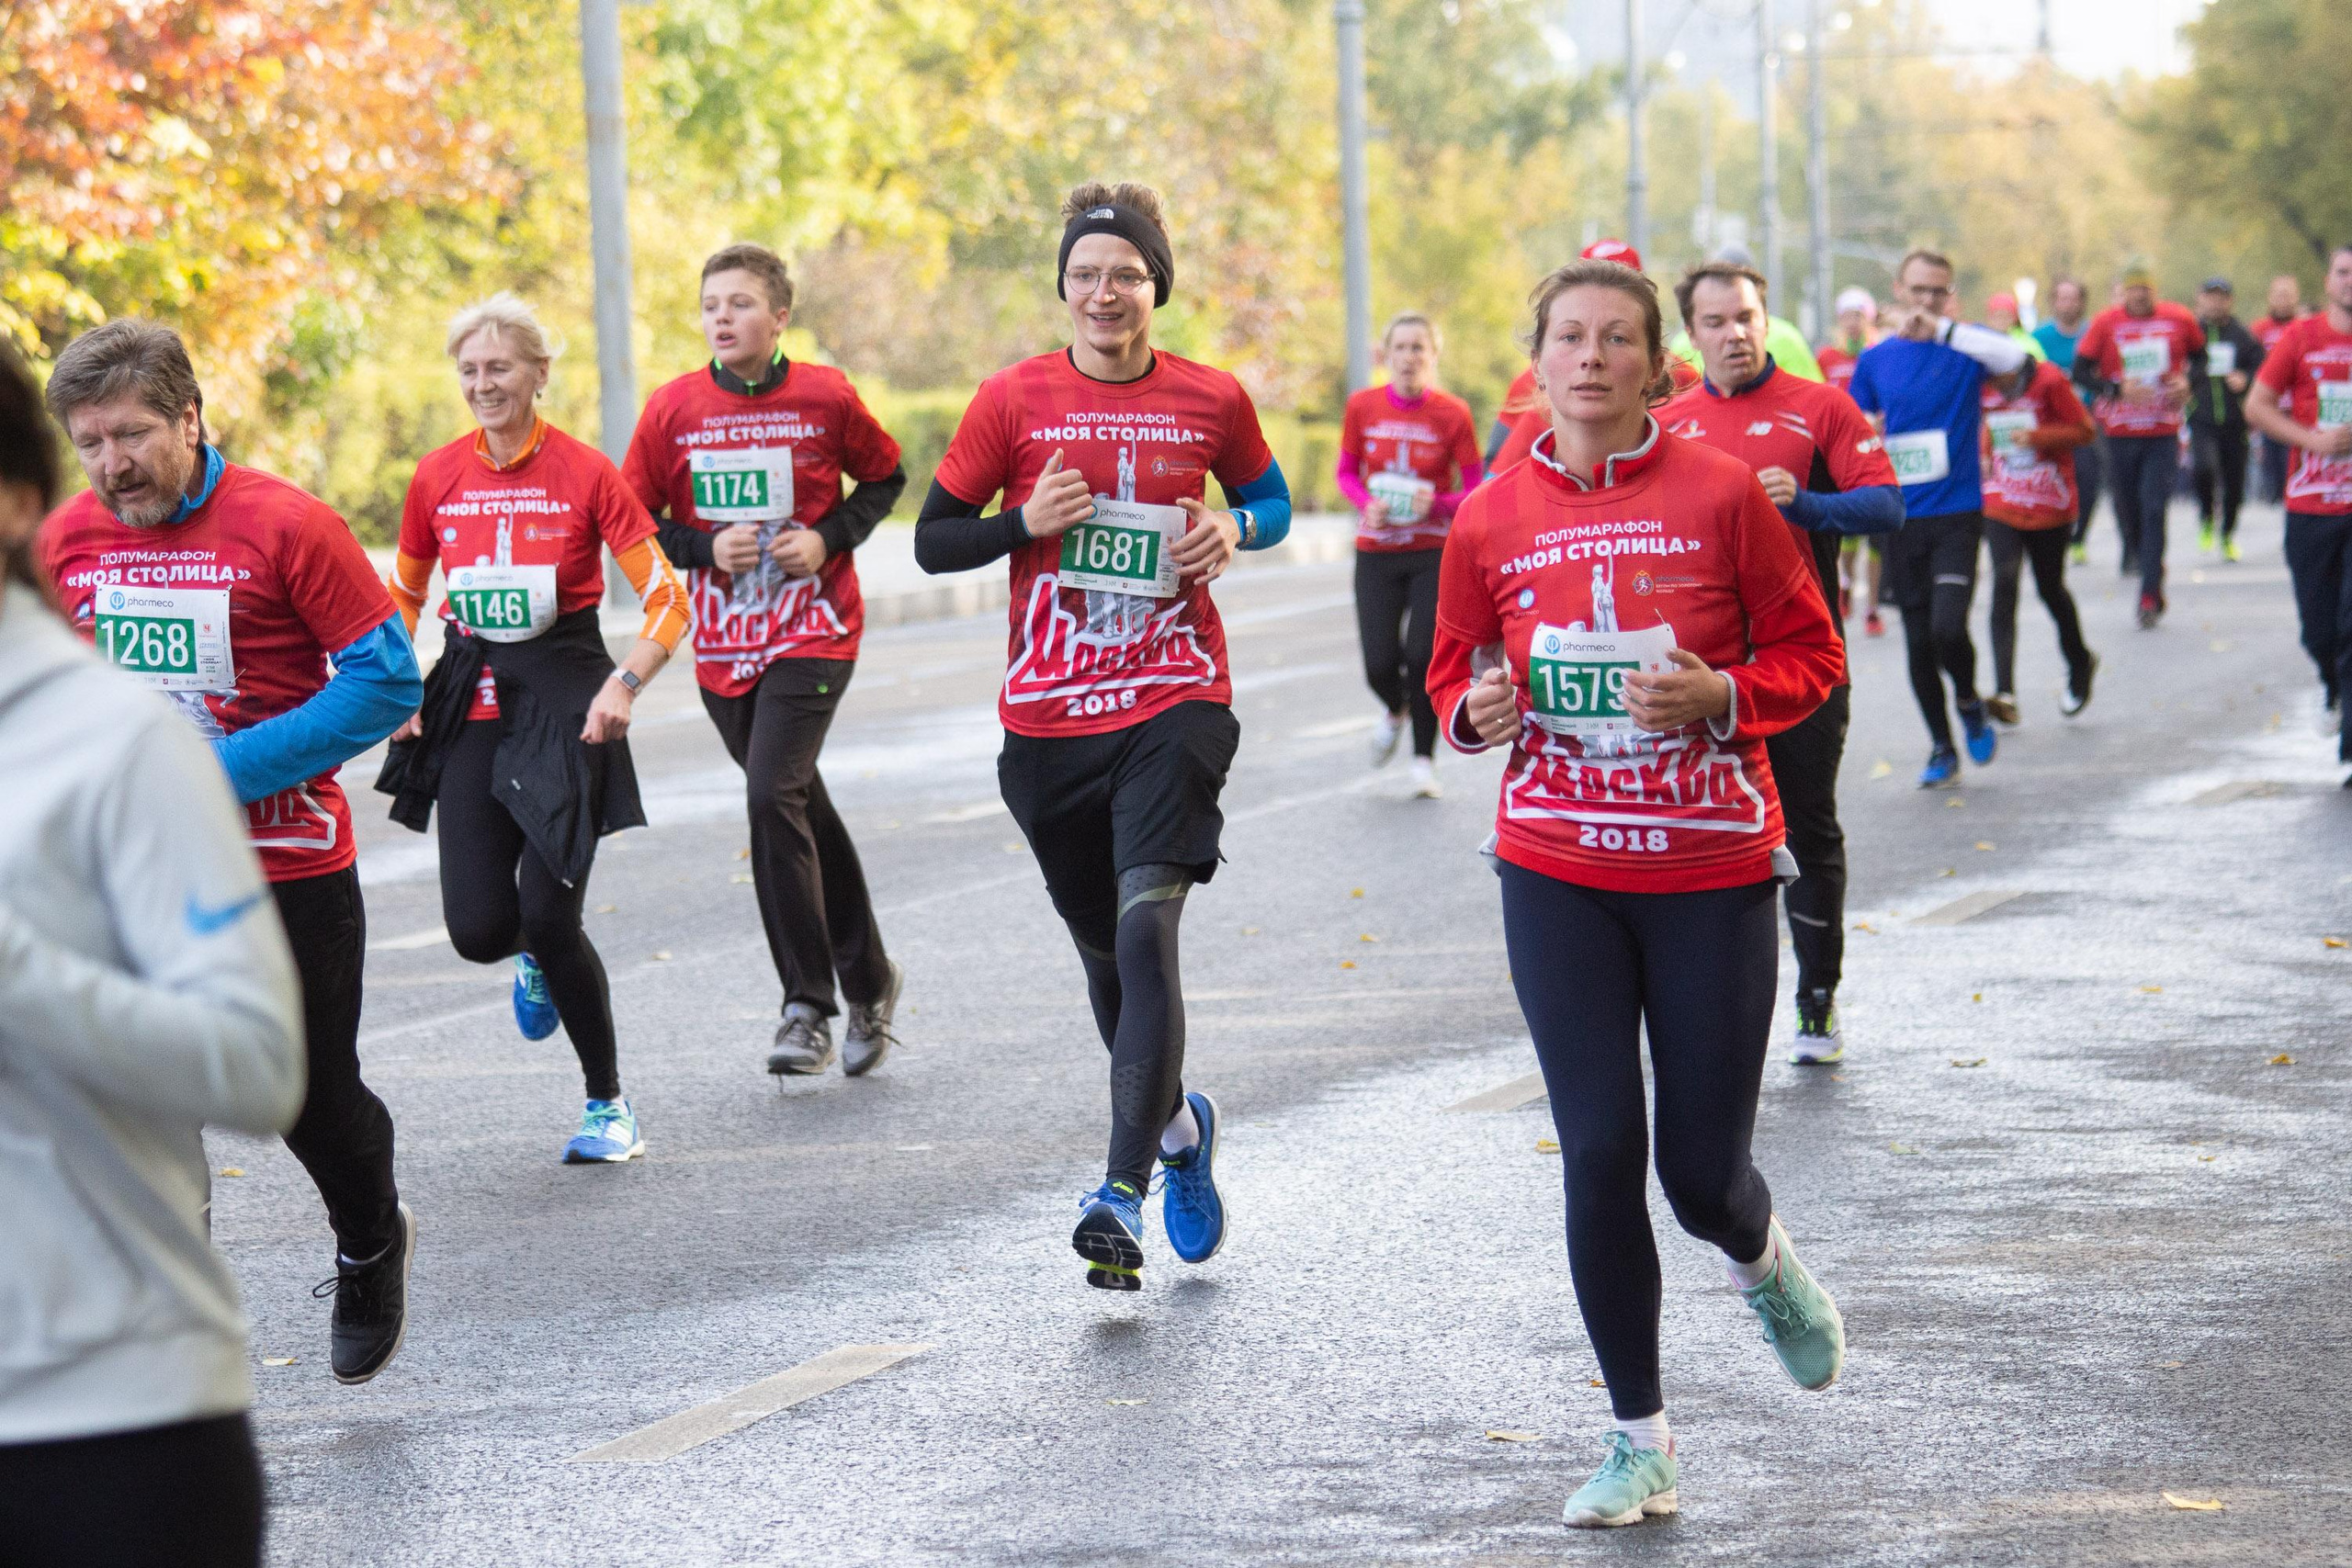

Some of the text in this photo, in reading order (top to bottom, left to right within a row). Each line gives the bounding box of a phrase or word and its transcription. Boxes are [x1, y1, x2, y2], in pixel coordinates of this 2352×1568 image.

[702, 412, 800, 428] ПОЛУМАРАФОН
[1066, 412, 1176, 424] ПОЛУМАРАФОН
[1031, 426, 1204, 444] «МОЯ СТОЛИЦА»
[462, 488, 547, 501] ПОЛУМАРАФОН
[700, 473, 761, 505] 1174
[436, 500, 571, 516] «МОЯ СТОЛИЦА»
[1100, 508, 1145, 521] pharmeco
[1535, 521, 1662, 547] ПОЛУМАРАФОН
[99, 551, 216, 566] ПОЛУМАРАФОН
[1072, 527, 1149, 574] 1681
[1499, 537, 1702, 575] «МОЯ СТОЛИЦА»
[67, 565, 252, 588] «МОЯ СТОЛИЦА»
[127, 597, 174, 607] pharmeco
[455, 592, 523, 626] 1146
[101, 619, 189, 668] 1268
[1563, 642, 1616, 652] pharmeco
[1538, 664, 1625, 712] 1579
[1067, 690, 1137, 716] 2018
[1578, 825, 1669, 852] 2018
